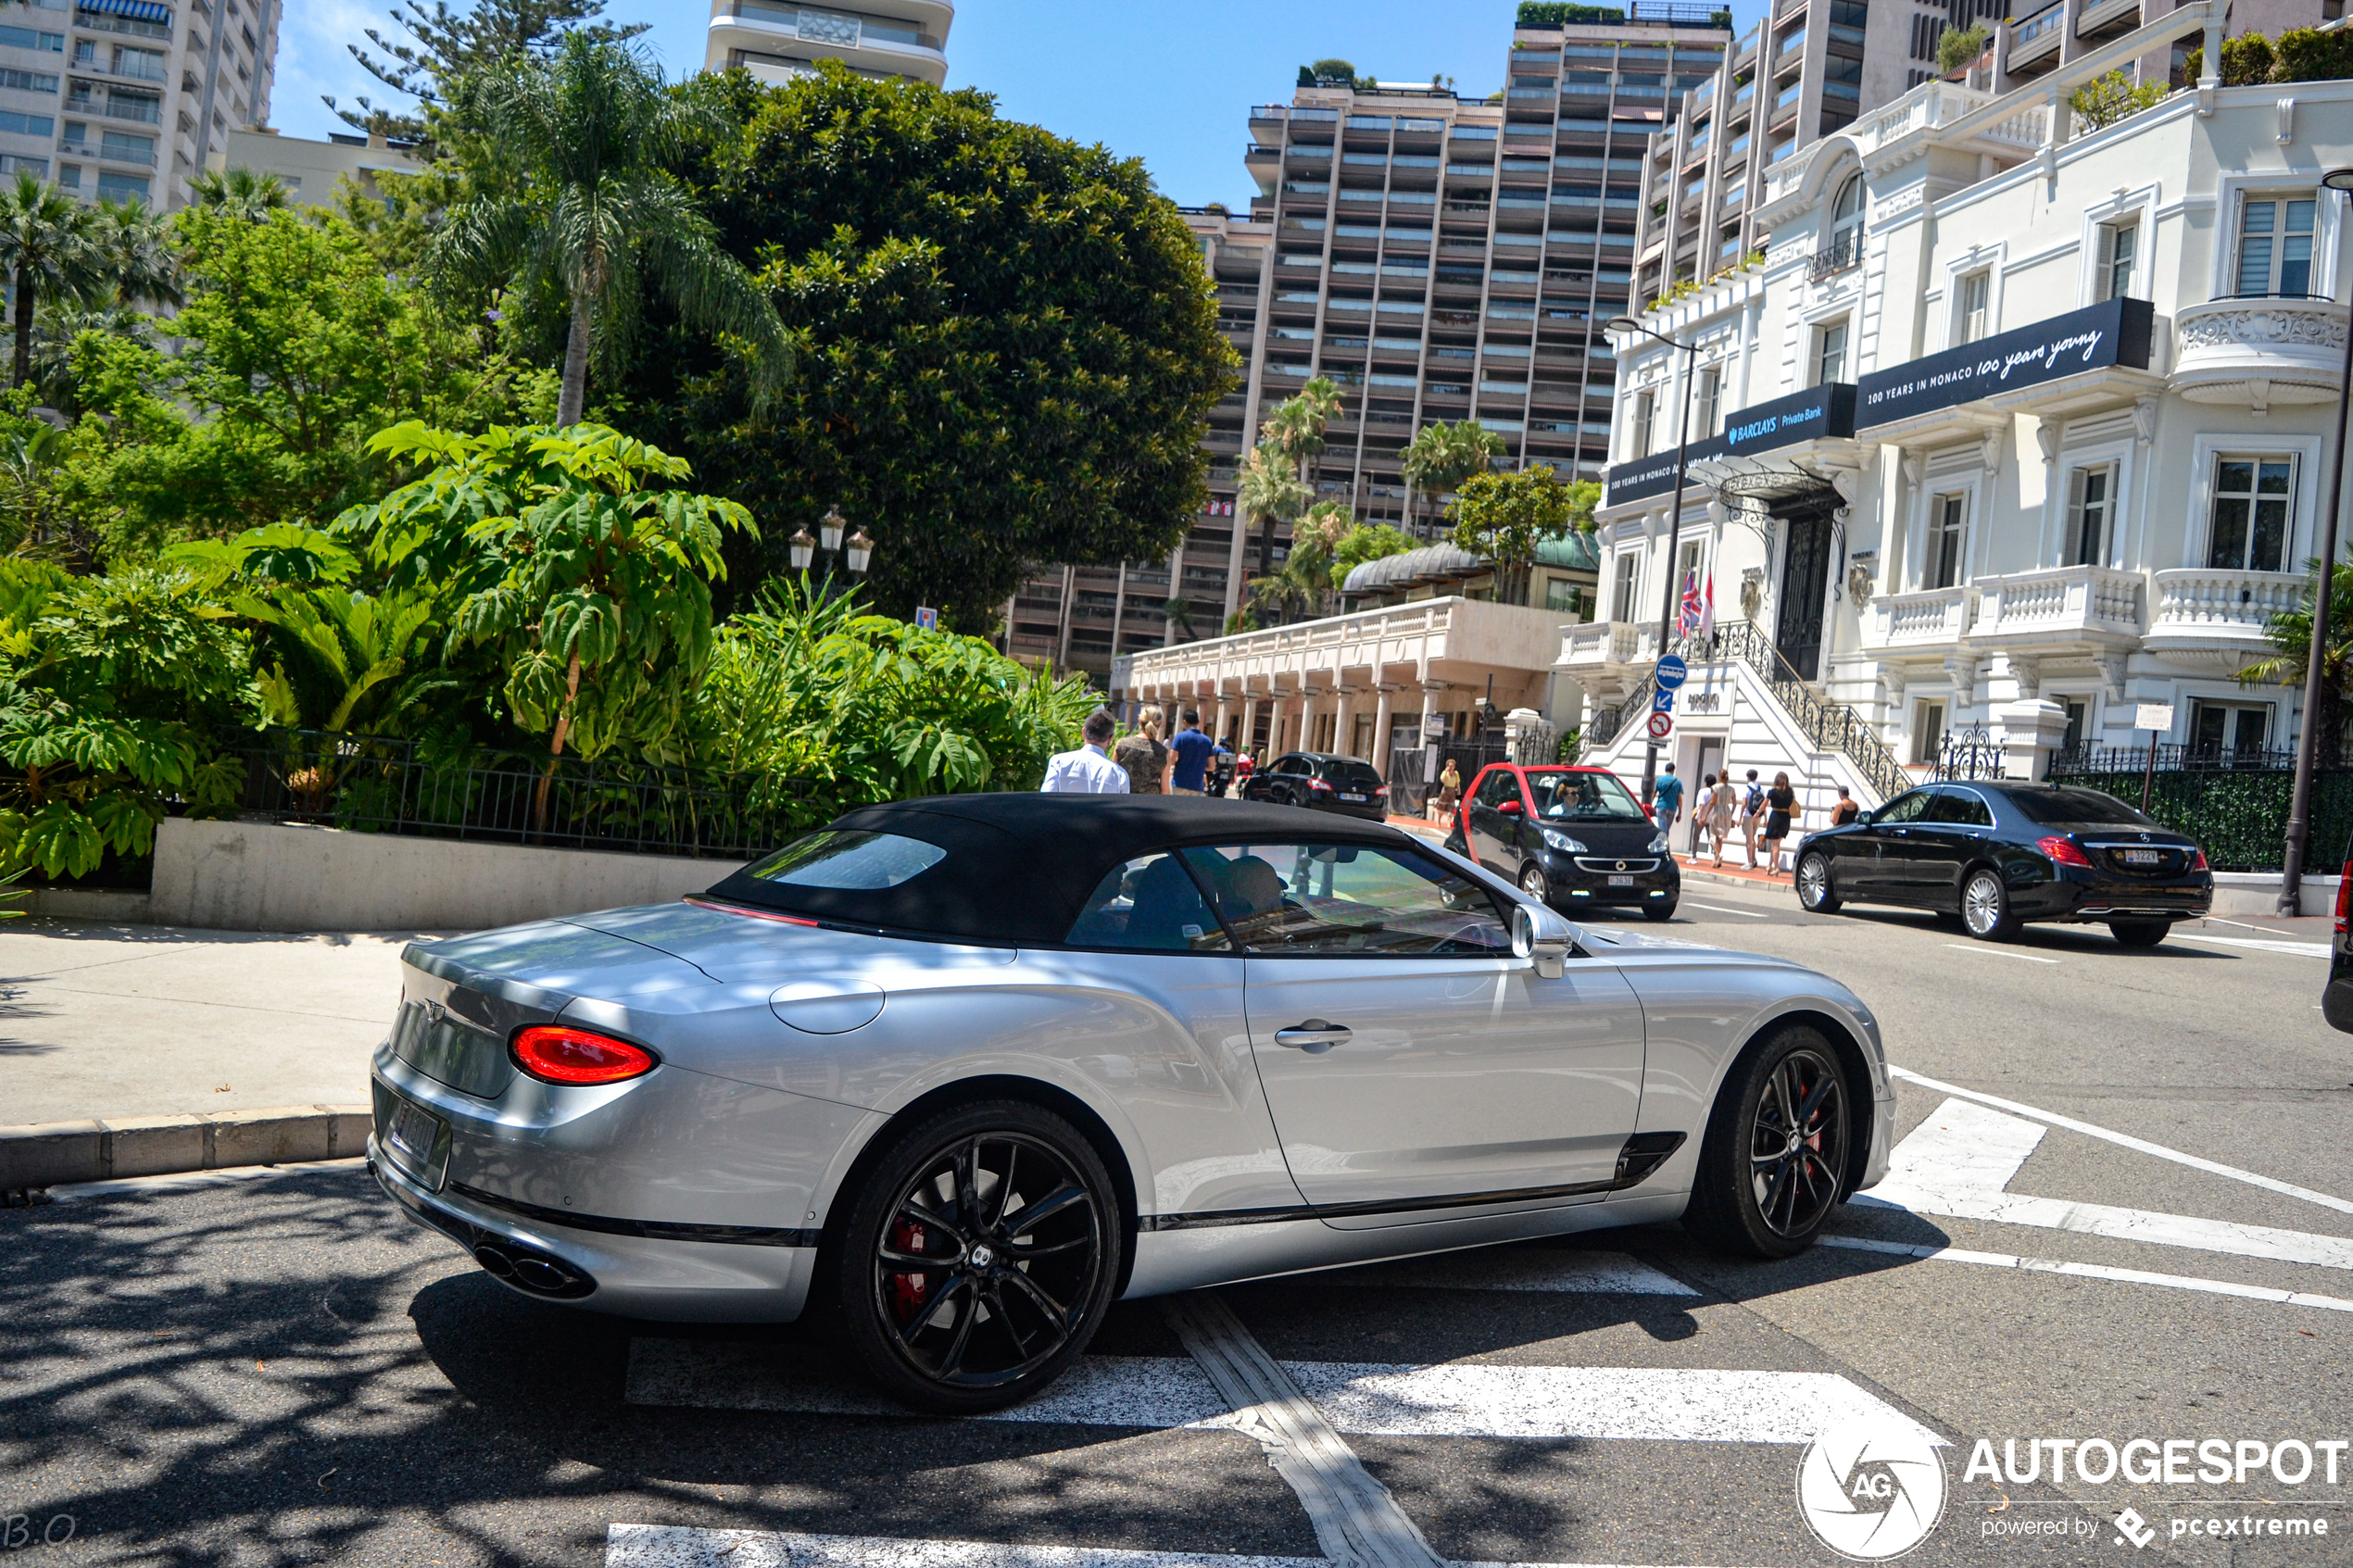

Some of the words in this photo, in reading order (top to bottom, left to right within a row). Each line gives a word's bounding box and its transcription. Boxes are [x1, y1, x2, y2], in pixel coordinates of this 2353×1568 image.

[1868, 392, 1882, 405] 100
[1886, 384, 1913, 399] YEARS
[1917, 379, 1927, 392] IN
[1930, 367, 1972, 387] MONACO
[1976, 360, 1999, 376] 100
[2000, 345, 2045, 380] years
[2045, 330, 2102, 370] young
[1737, 416, 1777, 442] BARCLAYS
[1781, 412, 1804, 427] Private
[1805, 406, 1822, 420] Bank
[1611, 481, 1621, 490] 100
[1621, 476, 1638, 487] YEARS
[1639, 473, 1646, 483] IN
[1646, 467, 1670, 480] MONACO
[2135, 850, 2156, 860] 322V
